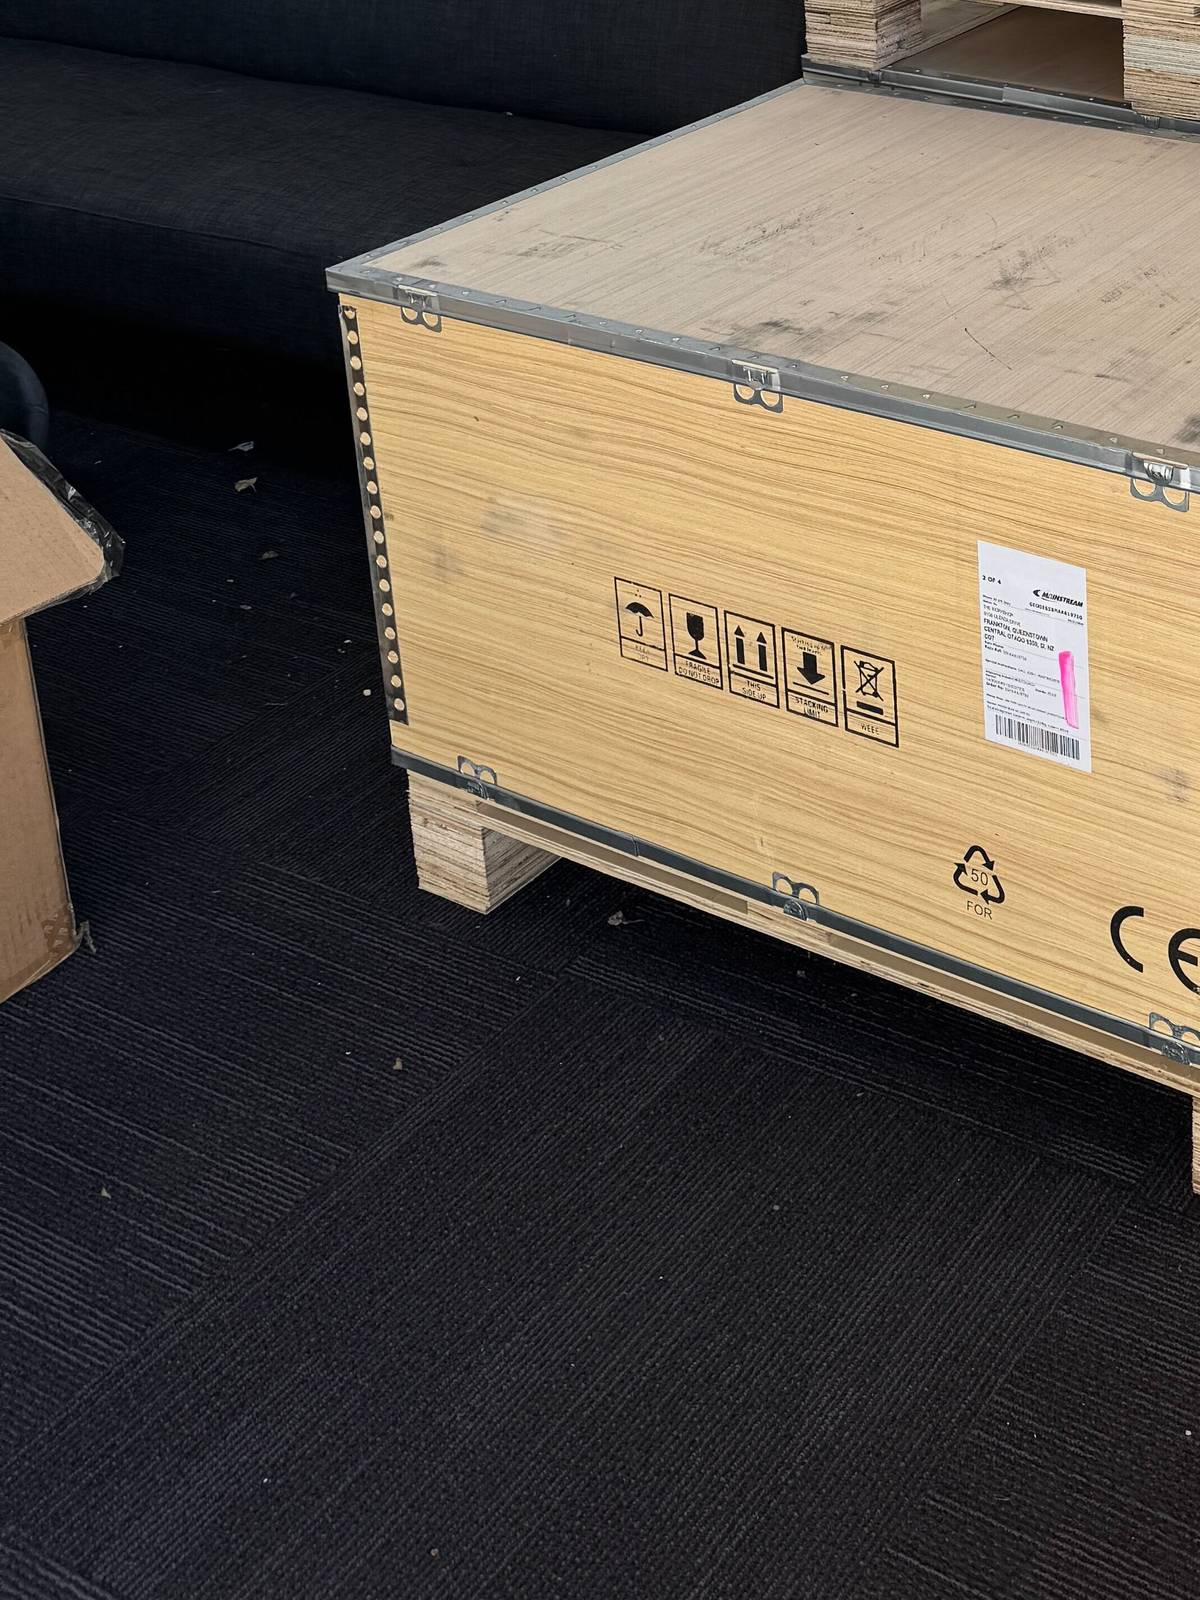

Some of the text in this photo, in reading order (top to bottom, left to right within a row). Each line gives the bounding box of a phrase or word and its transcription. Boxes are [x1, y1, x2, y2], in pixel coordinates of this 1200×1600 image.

[702, 673, 720, 685] DROP
[746, 680, 761, 692] THIS
[742, 687, 757, 698] SIDE
[795, 696, 830, 714] STACKING
[970, 868, 989, 886] 50
[966, 900, 993, 920] FOR
